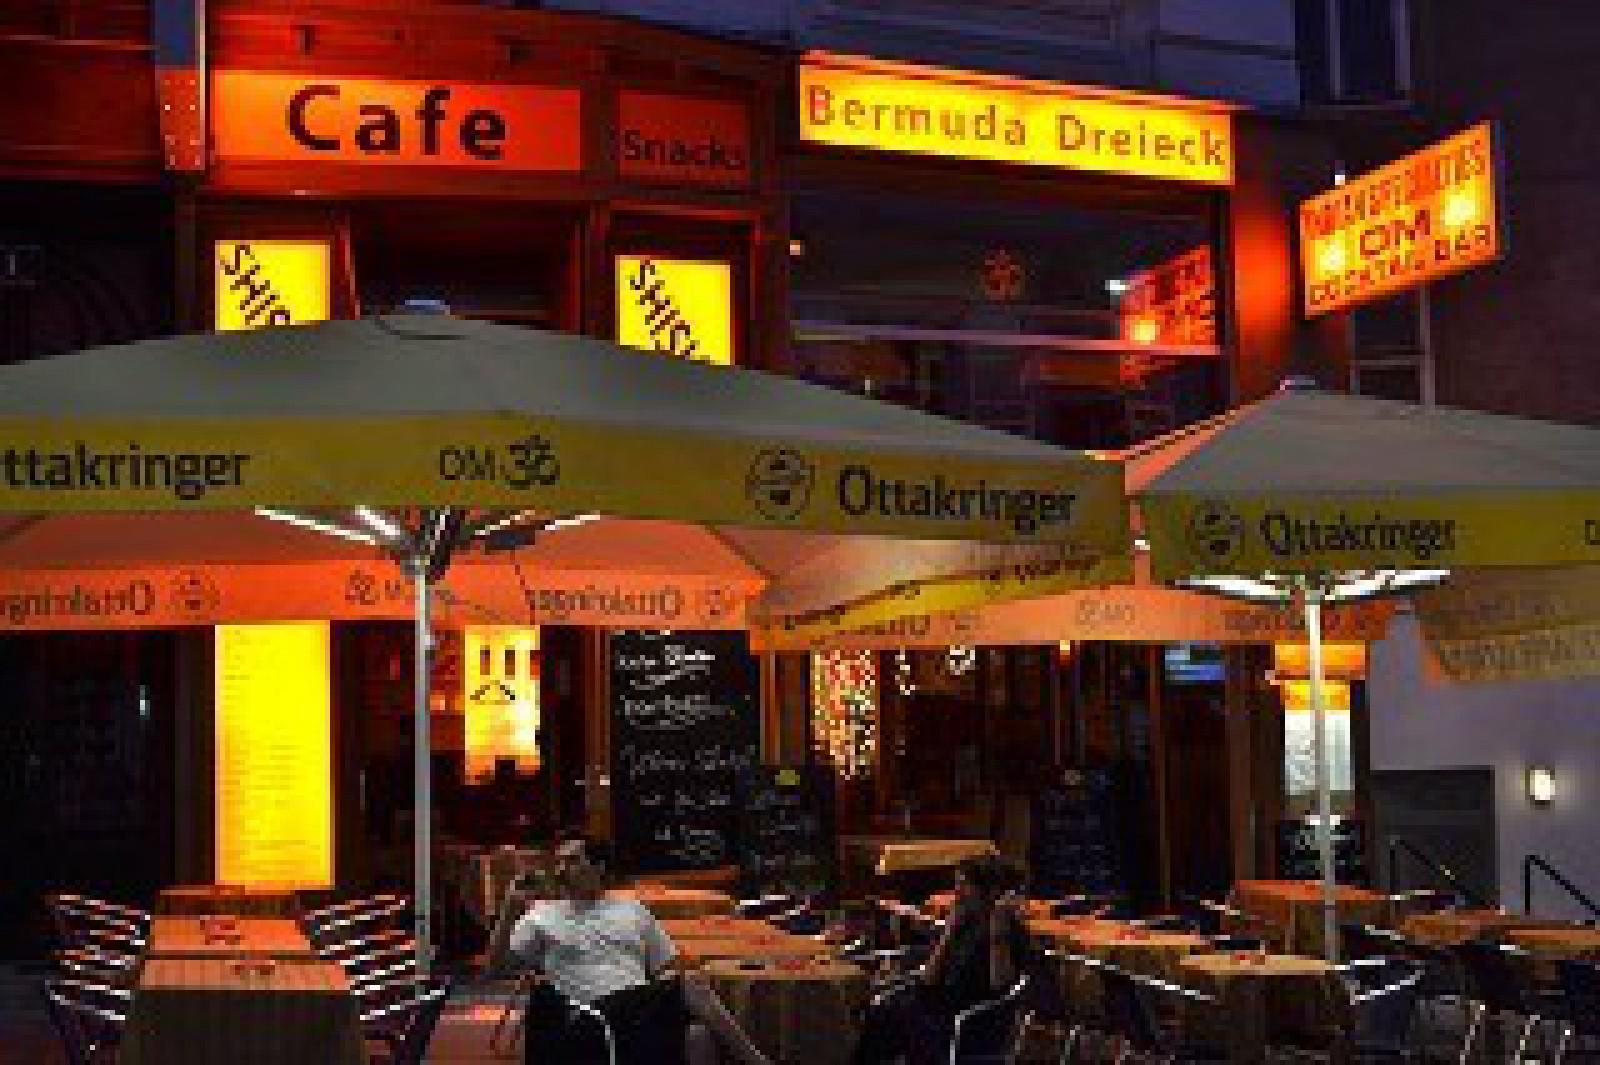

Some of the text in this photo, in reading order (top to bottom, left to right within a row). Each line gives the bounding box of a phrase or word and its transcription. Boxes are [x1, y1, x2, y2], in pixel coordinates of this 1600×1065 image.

[286, 84, 510, 161] Cafe
[621, 129, 745, 170] Snacks
[805, 84, 1228, 167] Bermuda Dreieck
[1360, 209, 1431, 257] OM
[4, 440, 250, 501] ttakringer
[837, 464, 1076, 536] Ottakringer
[1259, 510, 1456, 560] Ottakringer
